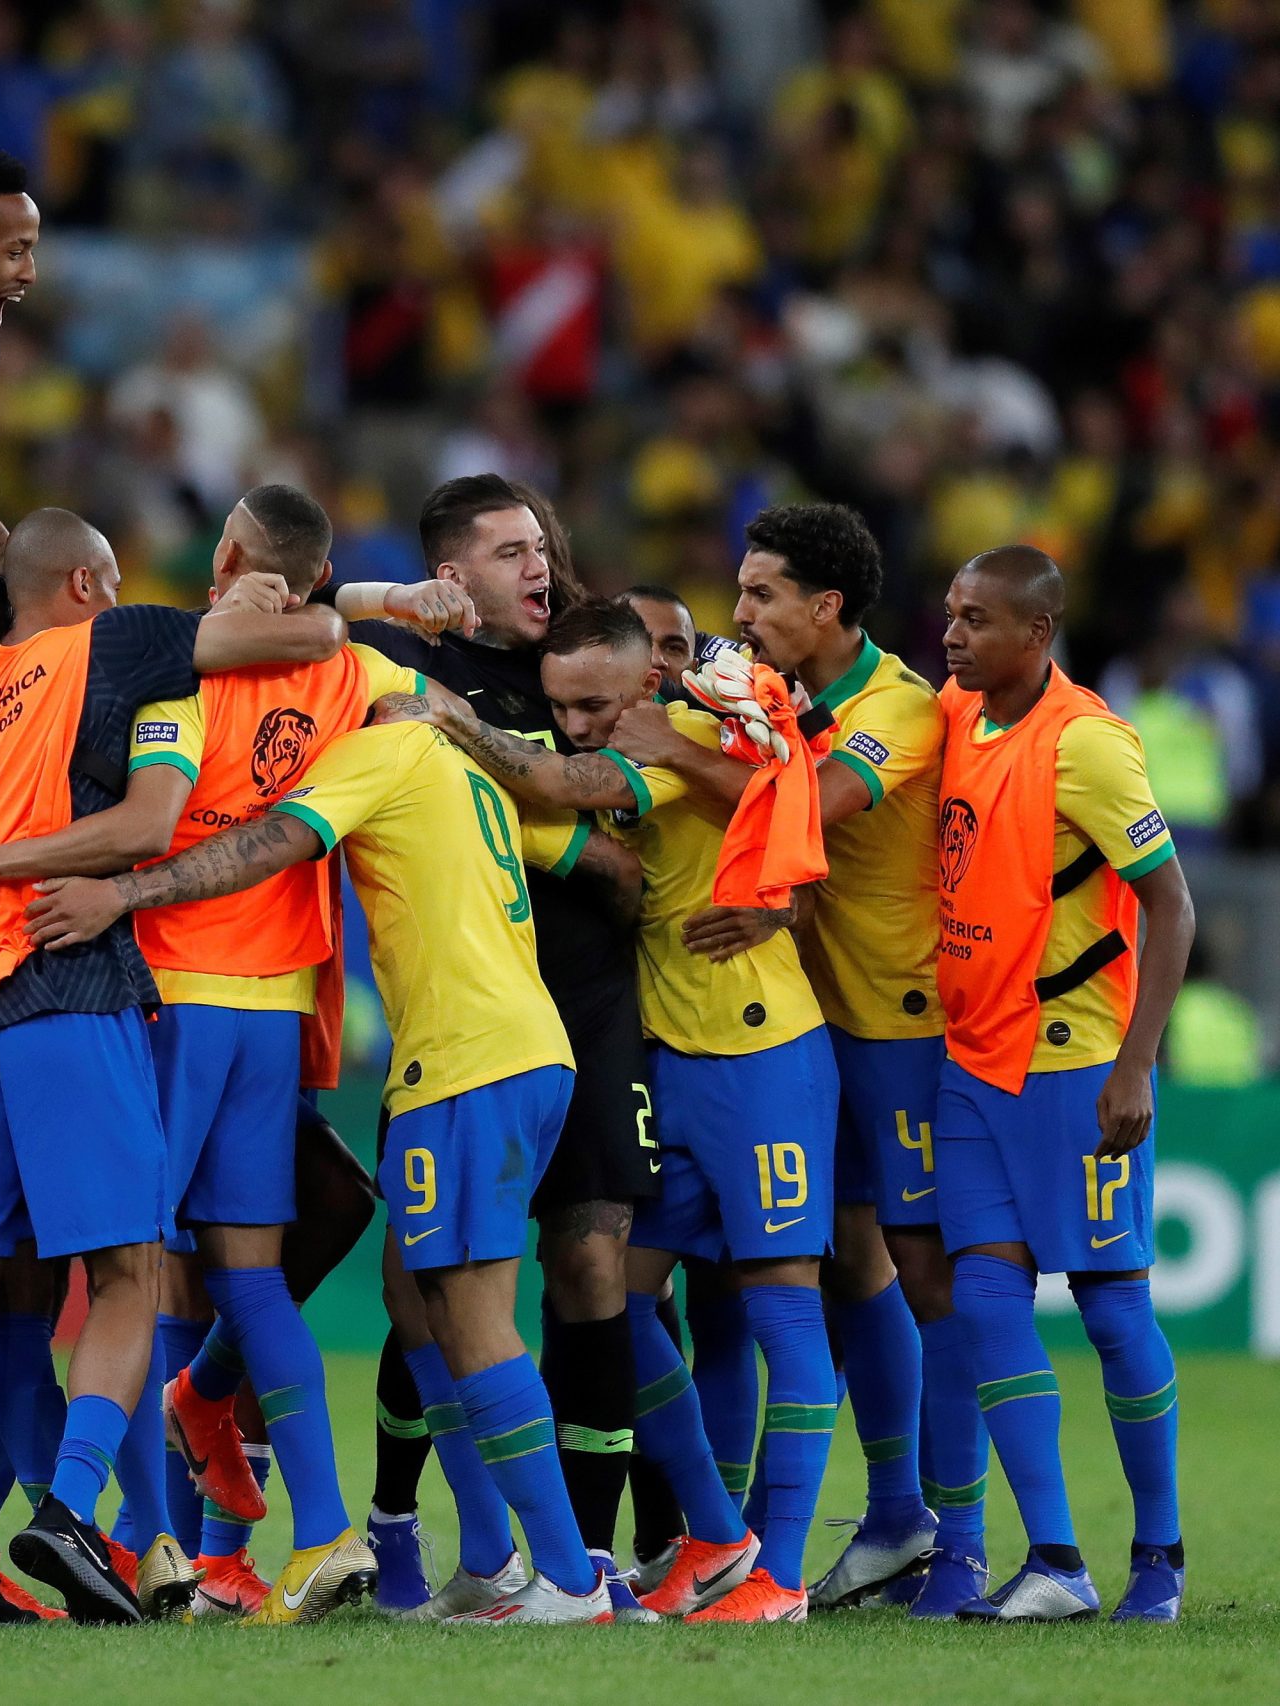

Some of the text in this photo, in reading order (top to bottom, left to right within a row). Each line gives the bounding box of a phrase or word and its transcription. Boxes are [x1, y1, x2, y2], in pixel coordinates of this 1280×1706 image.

[138, 724, 176, 733] Cree en
[848, 739, 880, 762] grande
[854, 732, 886, 758] Cree en
[1128, 813, 1160, 837] Cree en
[1133, 822, 1162, 847] grande
[464, 768, 531, 924] 9
[945, 940, 973, 961] 2019
[895, 1109, 934, 1174] 4
[404, 1147, 437, 1215] 9
[753, 1142, 809, 1210] 19
[1081, 1154, 1131, 1221] 17
